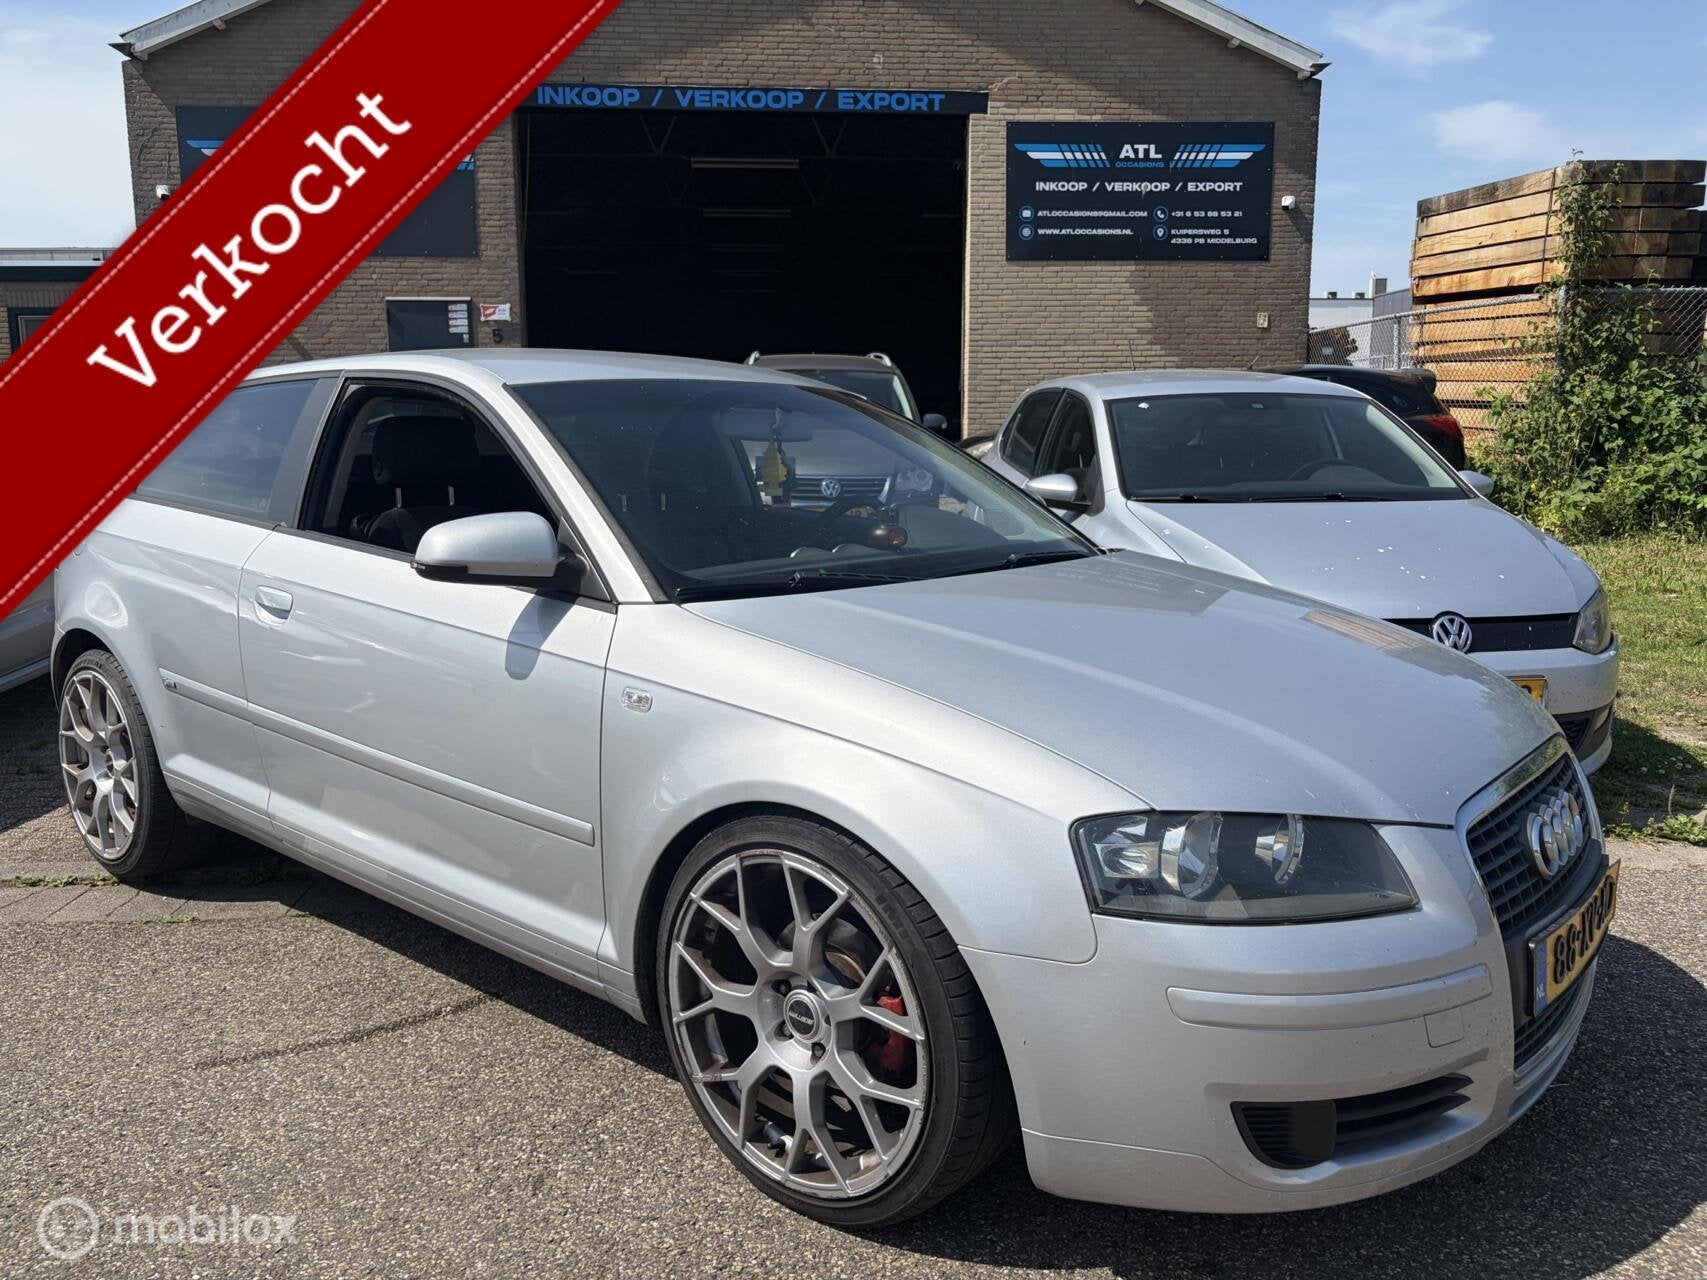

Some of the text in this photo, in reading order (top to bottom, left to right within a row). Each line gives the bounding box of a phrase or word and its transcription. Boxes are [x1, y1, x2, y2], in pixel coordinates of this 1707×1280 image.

[537, 86, 946, 112] INKOOP / VERKOOP / EXPORT
[1118, 143, 1163, 160] ATL
[1114, 160, 1165, 169] OCCASIONS
[1035, 181, 1244, 193] INKOOP / VERKOOP / EXPORT
